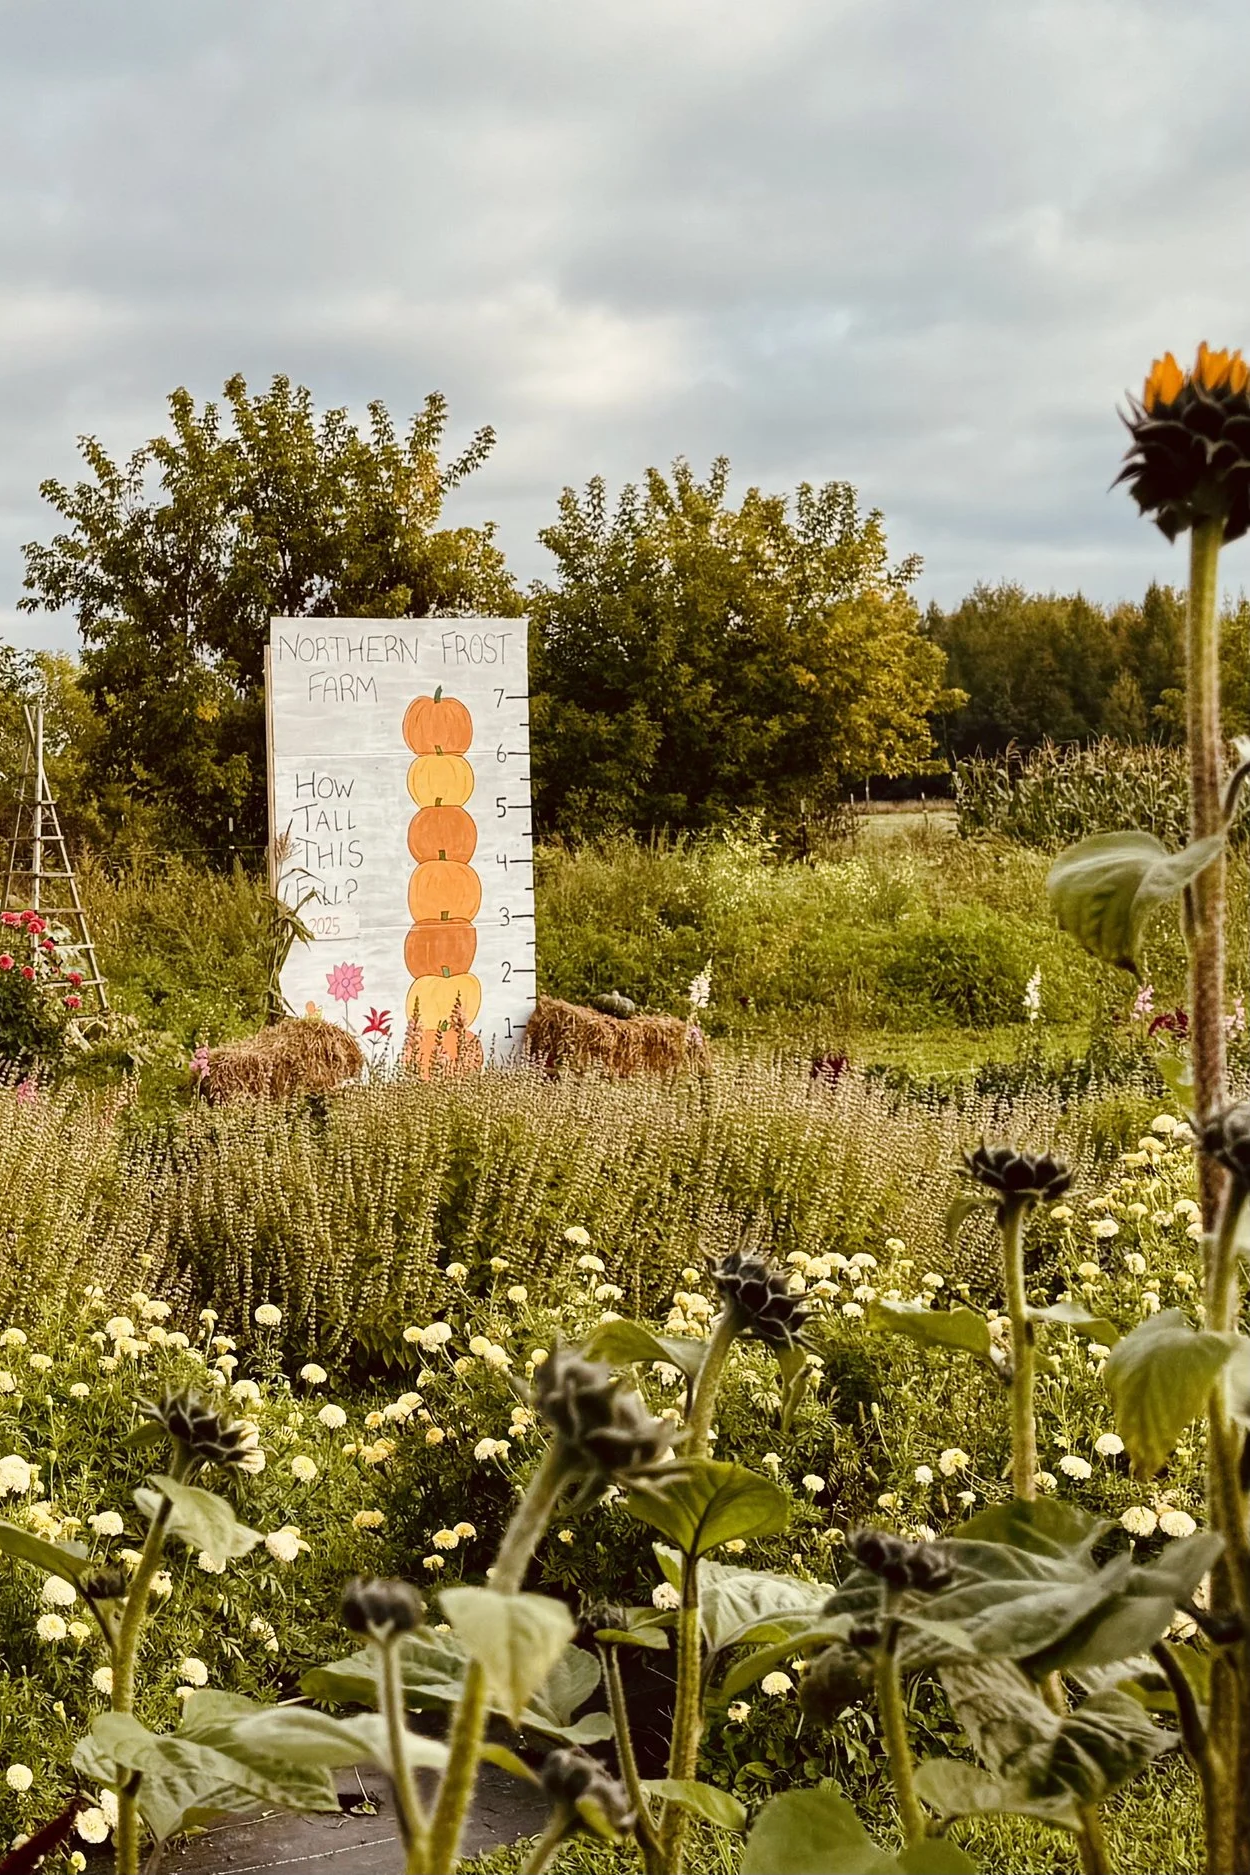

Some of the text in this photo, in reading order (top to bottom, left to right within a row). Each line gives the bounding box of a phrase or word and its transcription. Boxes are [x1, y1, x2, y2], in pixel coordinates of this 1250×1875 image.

[279, 631, 513, 664] NORTHERN FROST
[308, 671, 378, 703] FARM
[493, 688, 505, 708] 7
[496, 743, 507, 763] 6
[295, 771, 354, 799] HOW
[292, 803, 356, 832] TALL
[495, 797, 508, 818] 5
[295, 837, 364, 869] THIS
[495, 853, 508, 871] 4
[309, 916, 340, 935] 2025
[499, 906, 510, 926] 3
[500, 961, 512, 983] 2
[503, 1017, 513, 1039] 1
